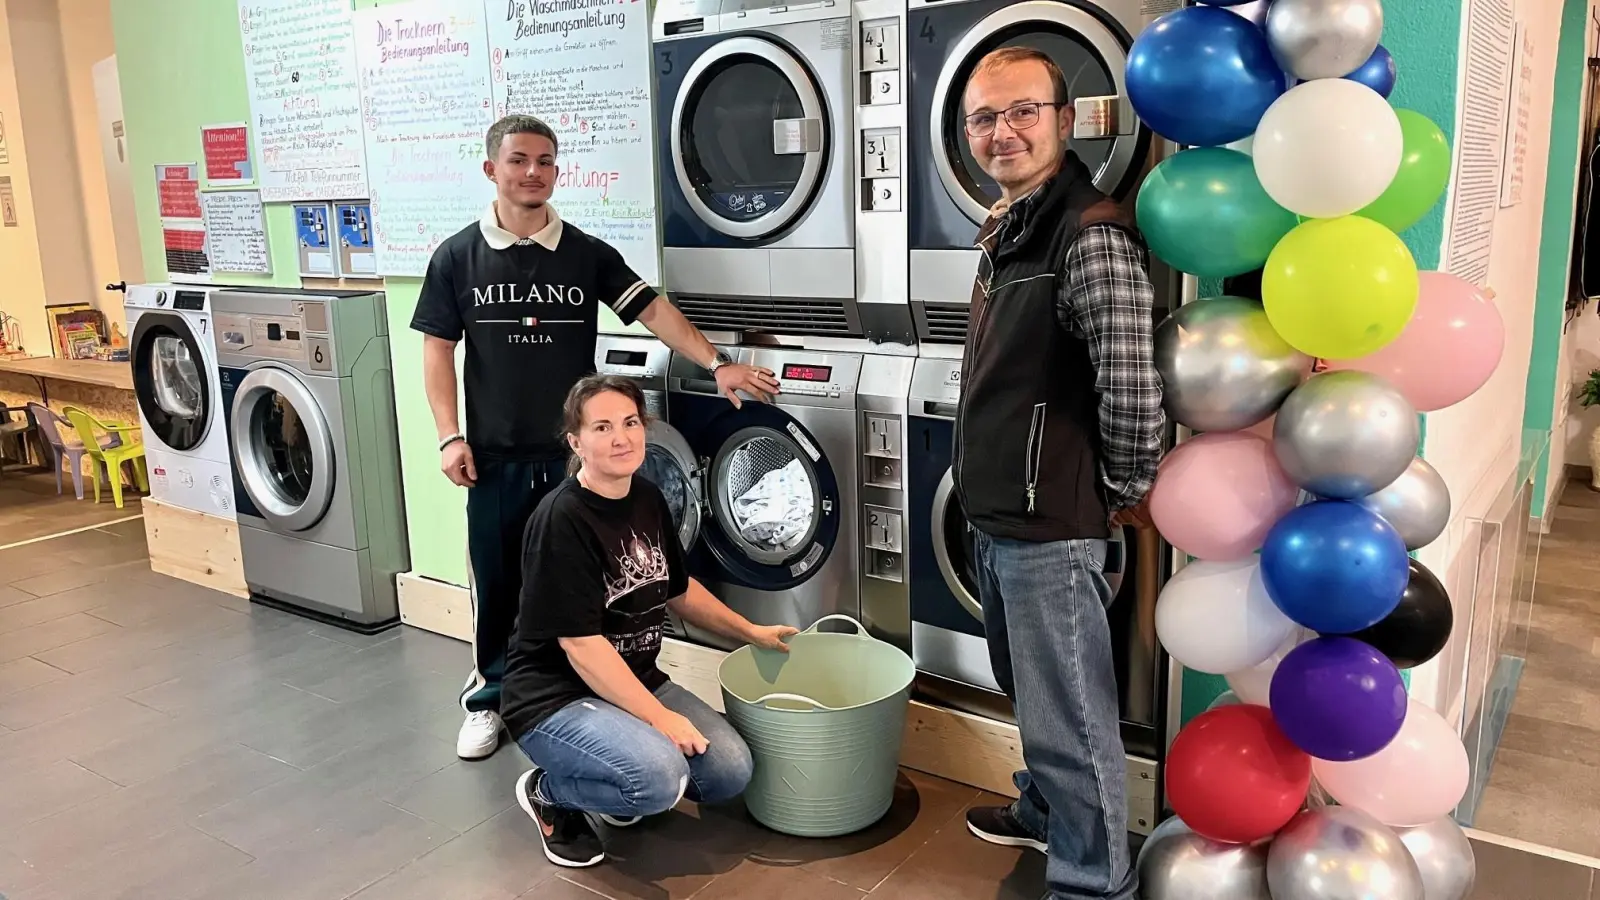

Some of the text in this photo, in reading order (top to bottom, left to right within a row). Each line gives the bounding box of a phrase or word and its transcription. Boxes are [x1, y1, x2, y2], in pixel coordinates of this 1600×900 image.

[506, 0, 525, 22] Die
[376, 20, 392, 46] Die
[395, 18, 445, 41] Trocknern
[513, 9, 626, 41] Bedienungsanleitung
[919, 16, 936, 44] 4
[865, 32, 874, 46] 4
[381, 37, 469, 63] Bedienungsanleitung
[661, 51, 674, 76] 3
[292, 71, 300, 83] 60
[867, 140, 876, 155] 3
[584, 208, 592, 217] 2
[472, 283, 584, 307] MILANO
[200, 319, 207, 335] 7
[508, 334, 553, 344] ITALIA
[314, 345, 324, 364] 6
[871, 421, 876, 433] 1
[922, 428, 932, 451] 1
[869, 514, 878, 527] 2
